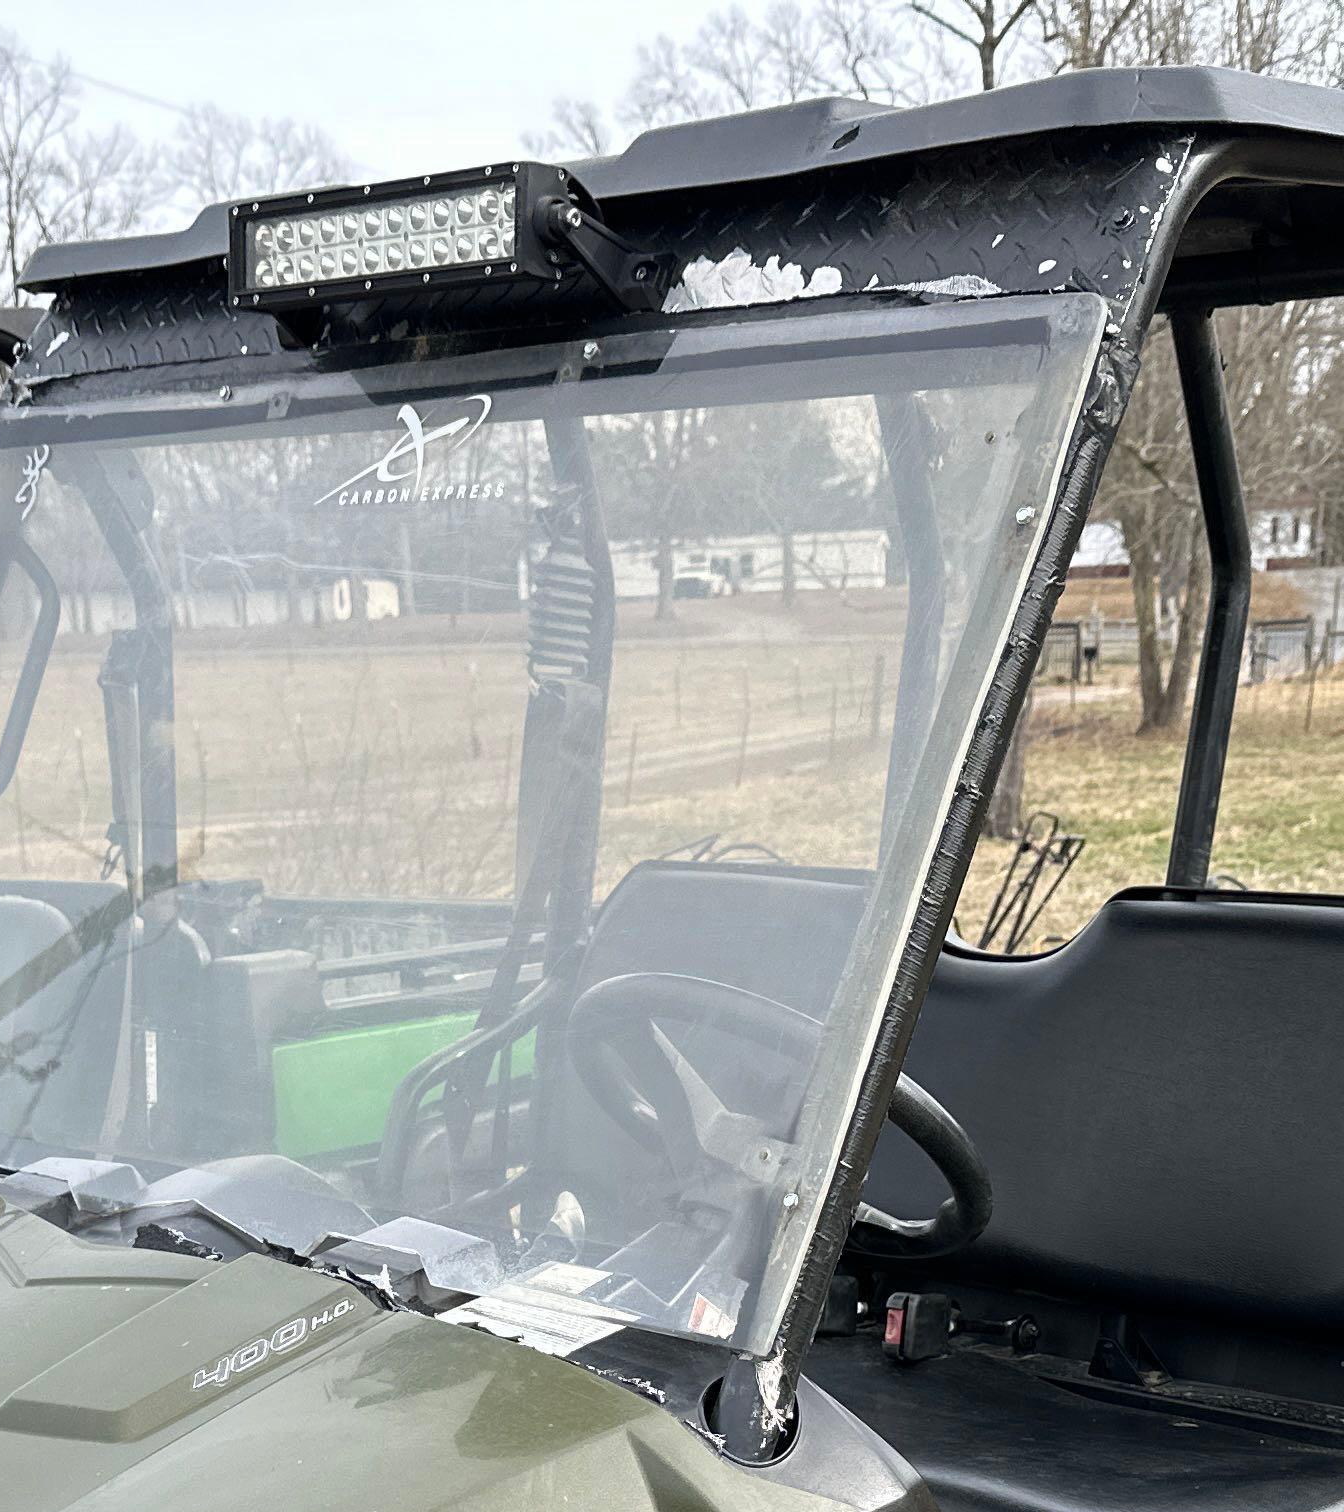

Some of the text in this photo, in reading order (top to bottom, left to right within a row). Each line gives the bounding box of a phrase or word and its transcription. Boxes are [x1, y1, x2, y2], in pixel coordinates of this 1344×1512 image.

[338, 481, 505, 506] CARBON EXPRESS
[192, 1317, 308, 1389] 400
